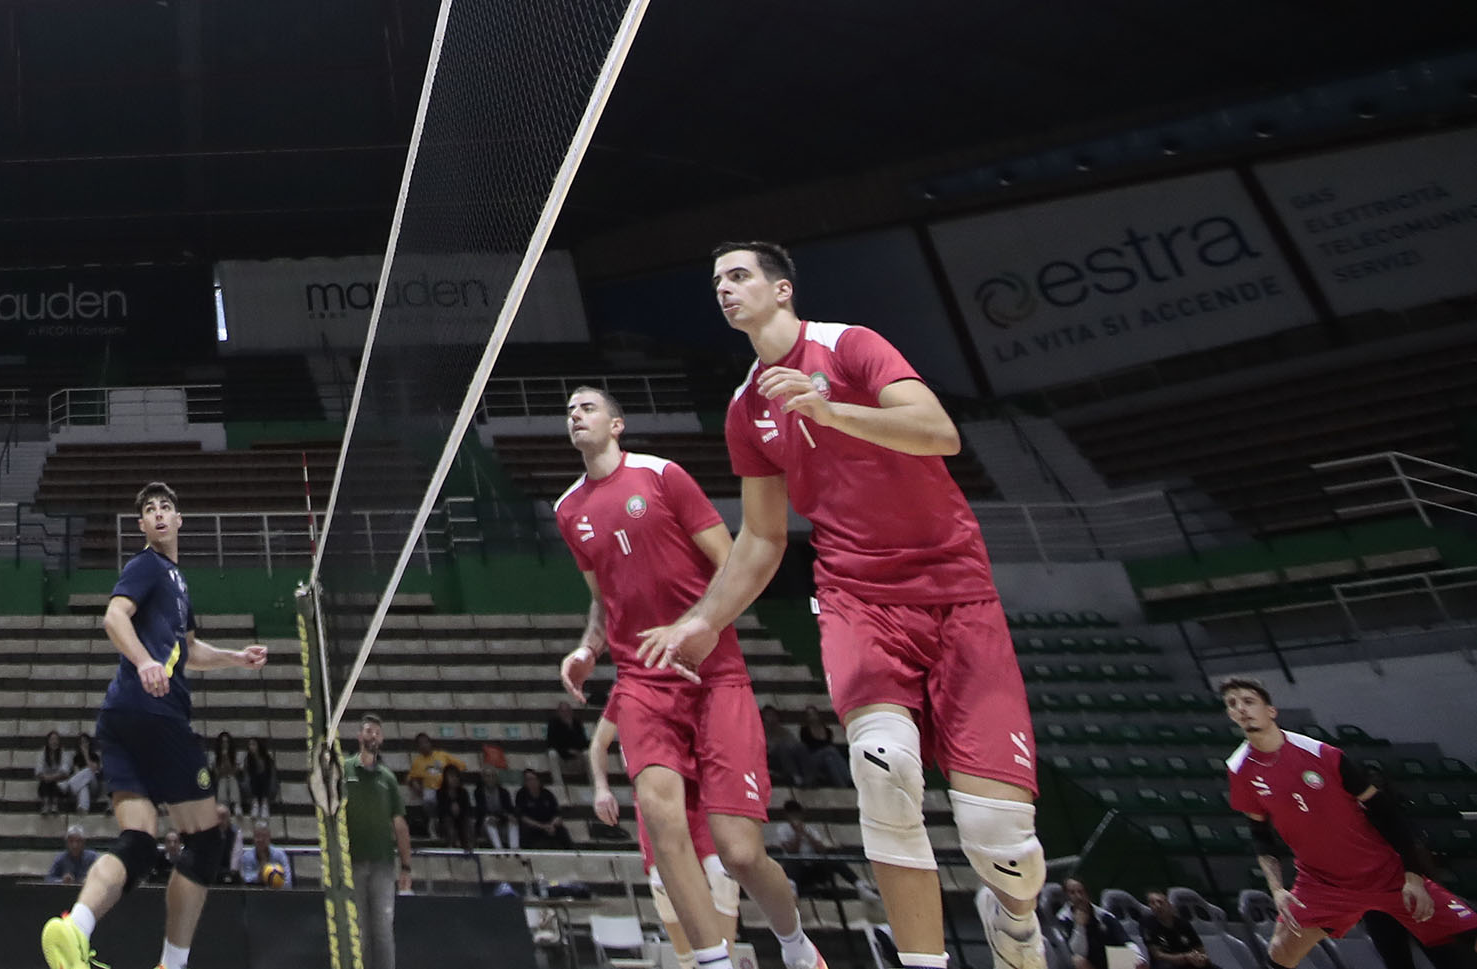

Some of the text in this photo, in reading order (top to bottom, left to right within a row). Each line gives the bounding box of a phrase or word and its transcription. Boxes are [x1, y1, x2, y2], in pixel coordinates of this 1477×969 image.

[1290, 187, 1336, 210] GAS
[1036, 217, 1262, 307] estra
[993, 275, 1282, 363] LA VITA SI ACCENDE
[613, 528, 633, 556] 11
[1291, 792, 1310, 813] 3
